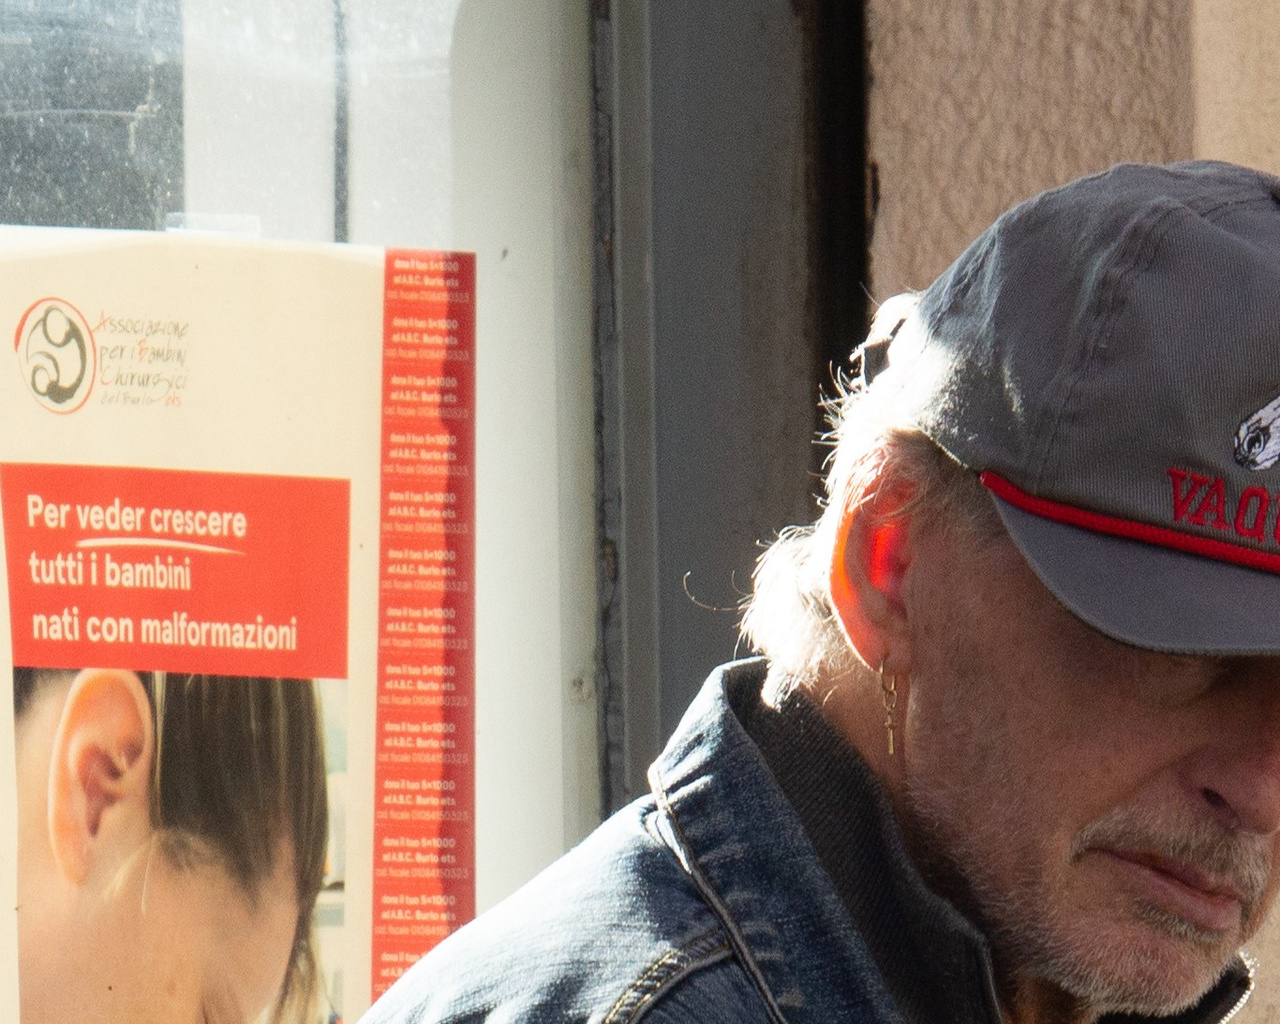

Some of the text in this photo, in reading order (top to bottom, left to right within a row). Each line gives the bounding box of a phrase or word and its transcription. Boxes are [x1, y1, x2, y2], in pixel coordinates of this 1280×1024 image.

[100, 345, 126, 373] per
[27, 494, 247, 538] Per veder crescere
[29, 551, 191, 590] tutti i bambini
[32, 606, 297, 650] nati con malformazioni
